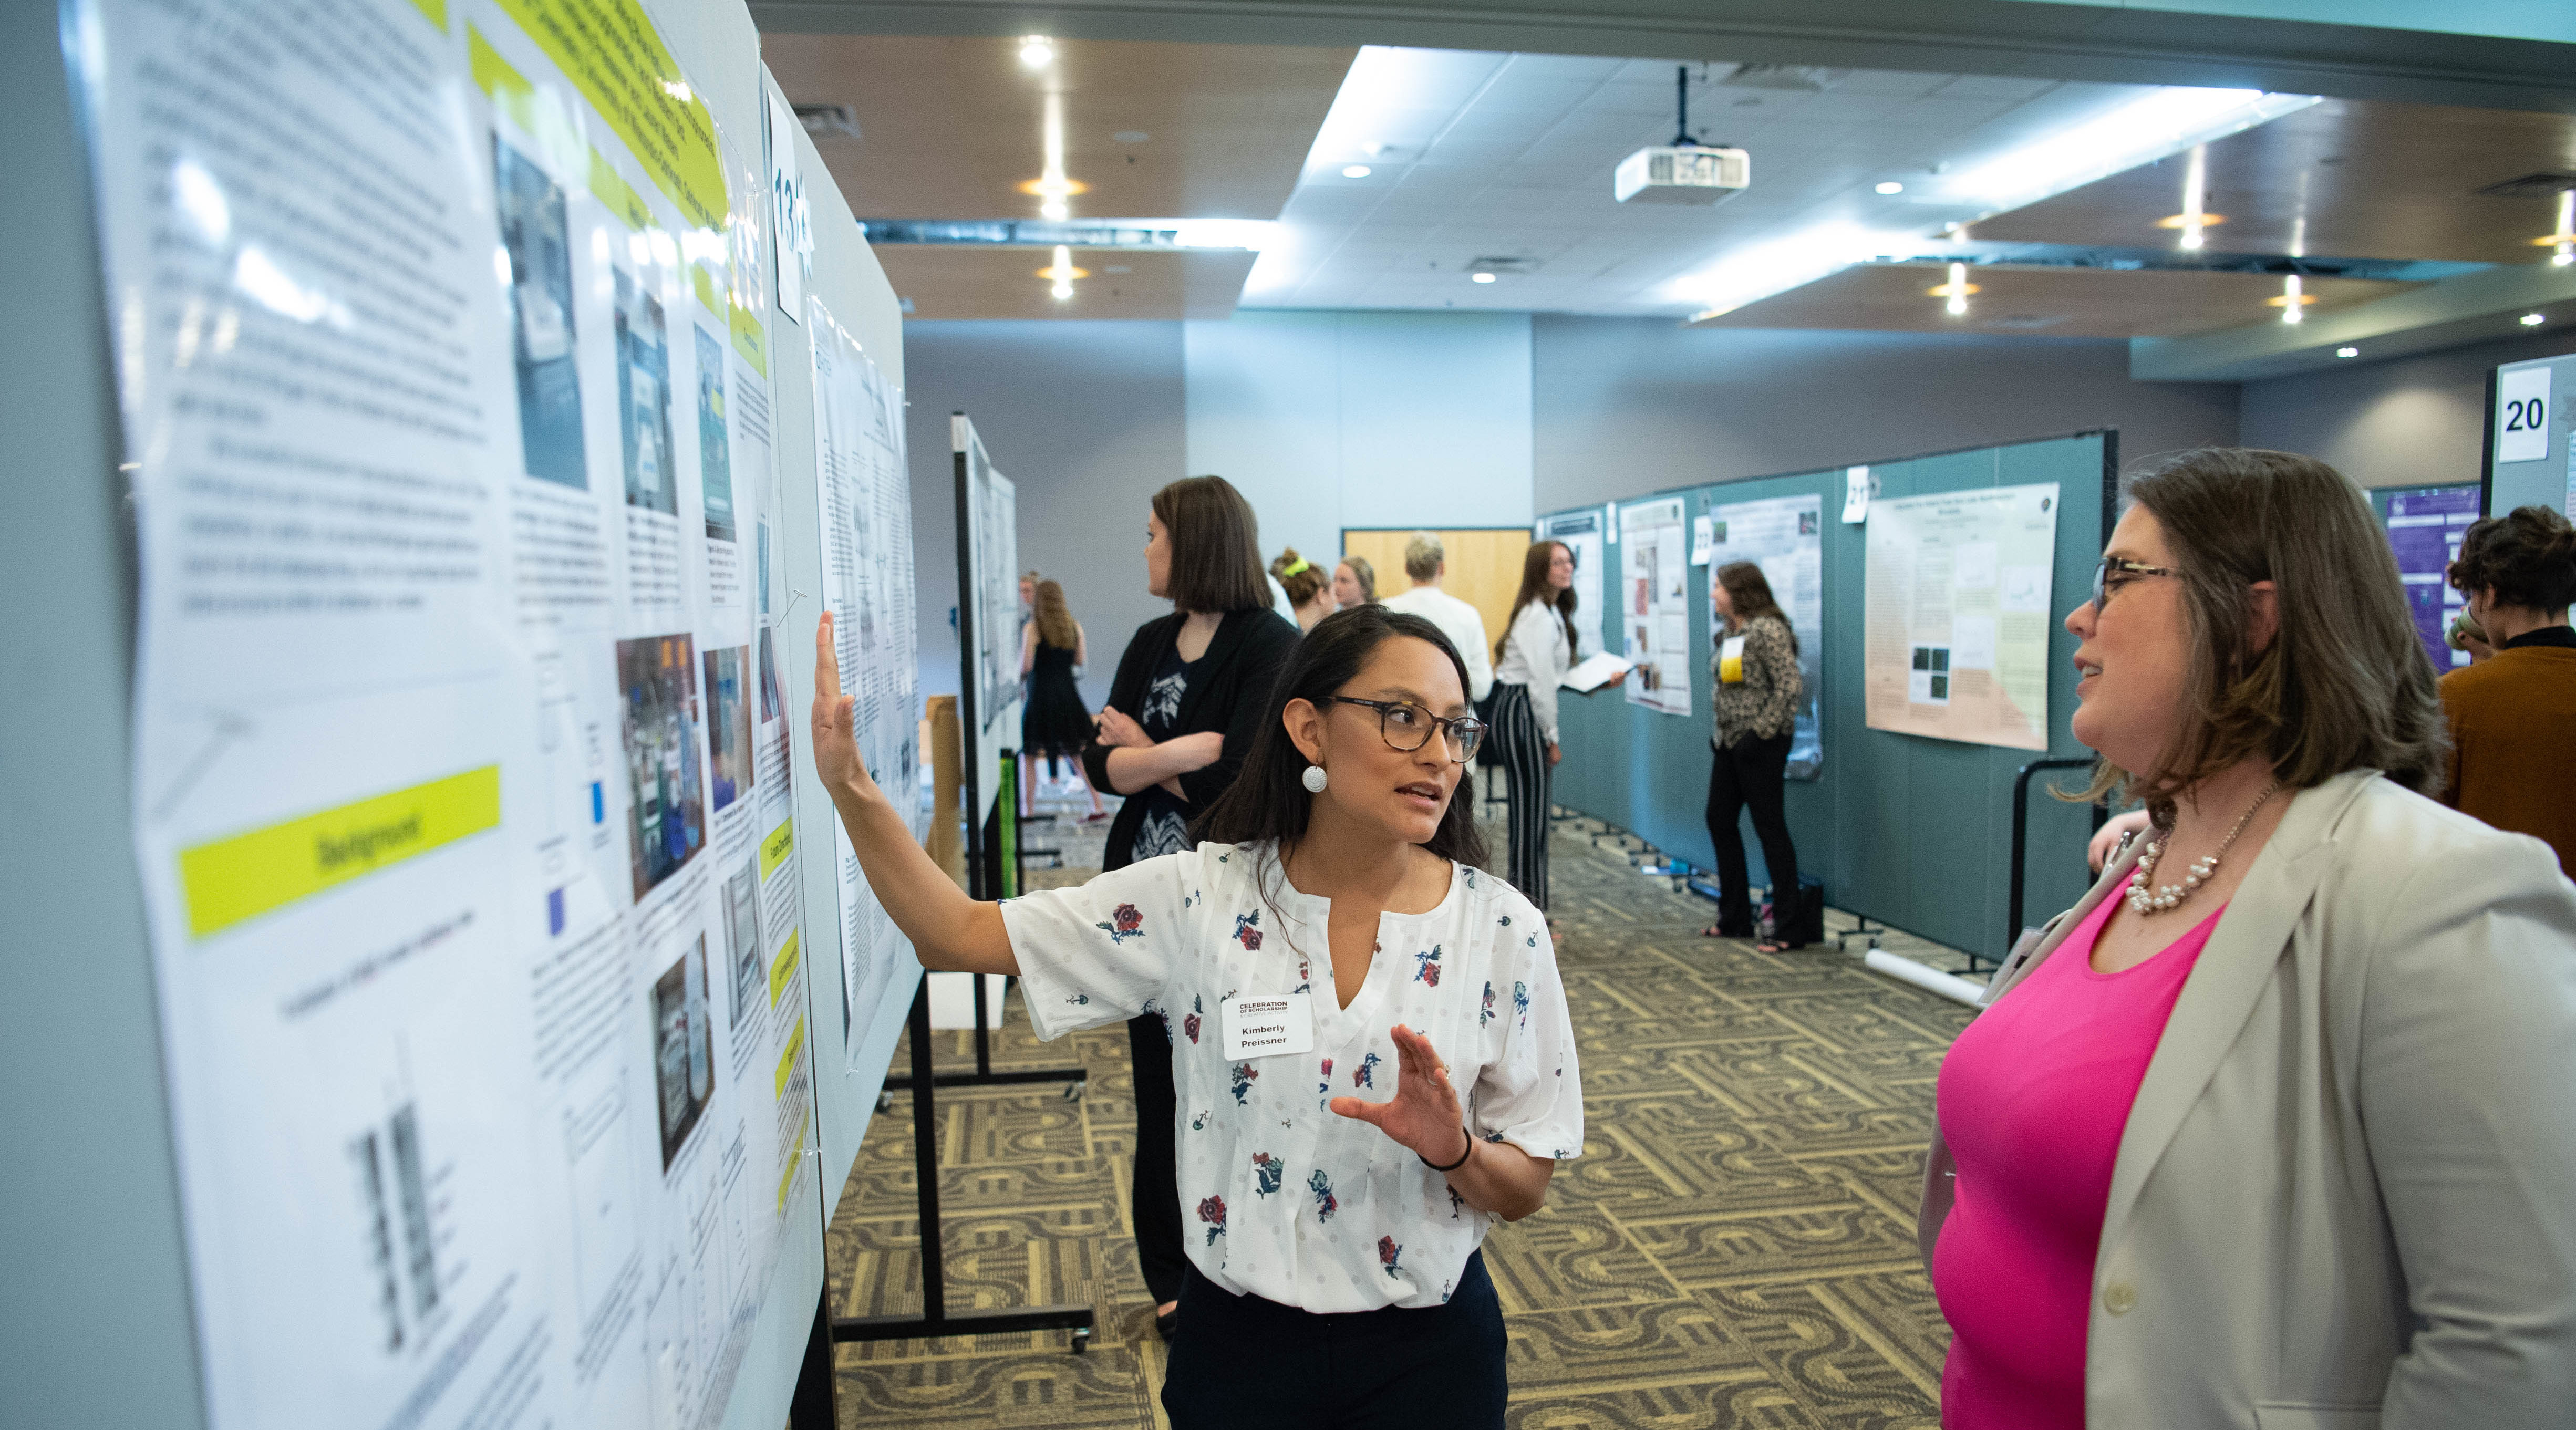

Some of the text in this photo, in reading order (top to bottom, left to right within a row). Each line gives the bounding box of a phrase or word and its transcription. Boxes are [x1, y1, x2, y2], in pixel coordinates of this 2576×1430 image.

[2506, 398, 2544, 432] 20
[1242, 1024, 1285, 1035] Kimberly
[1242, 1038, 1287, 1048] Preissner
